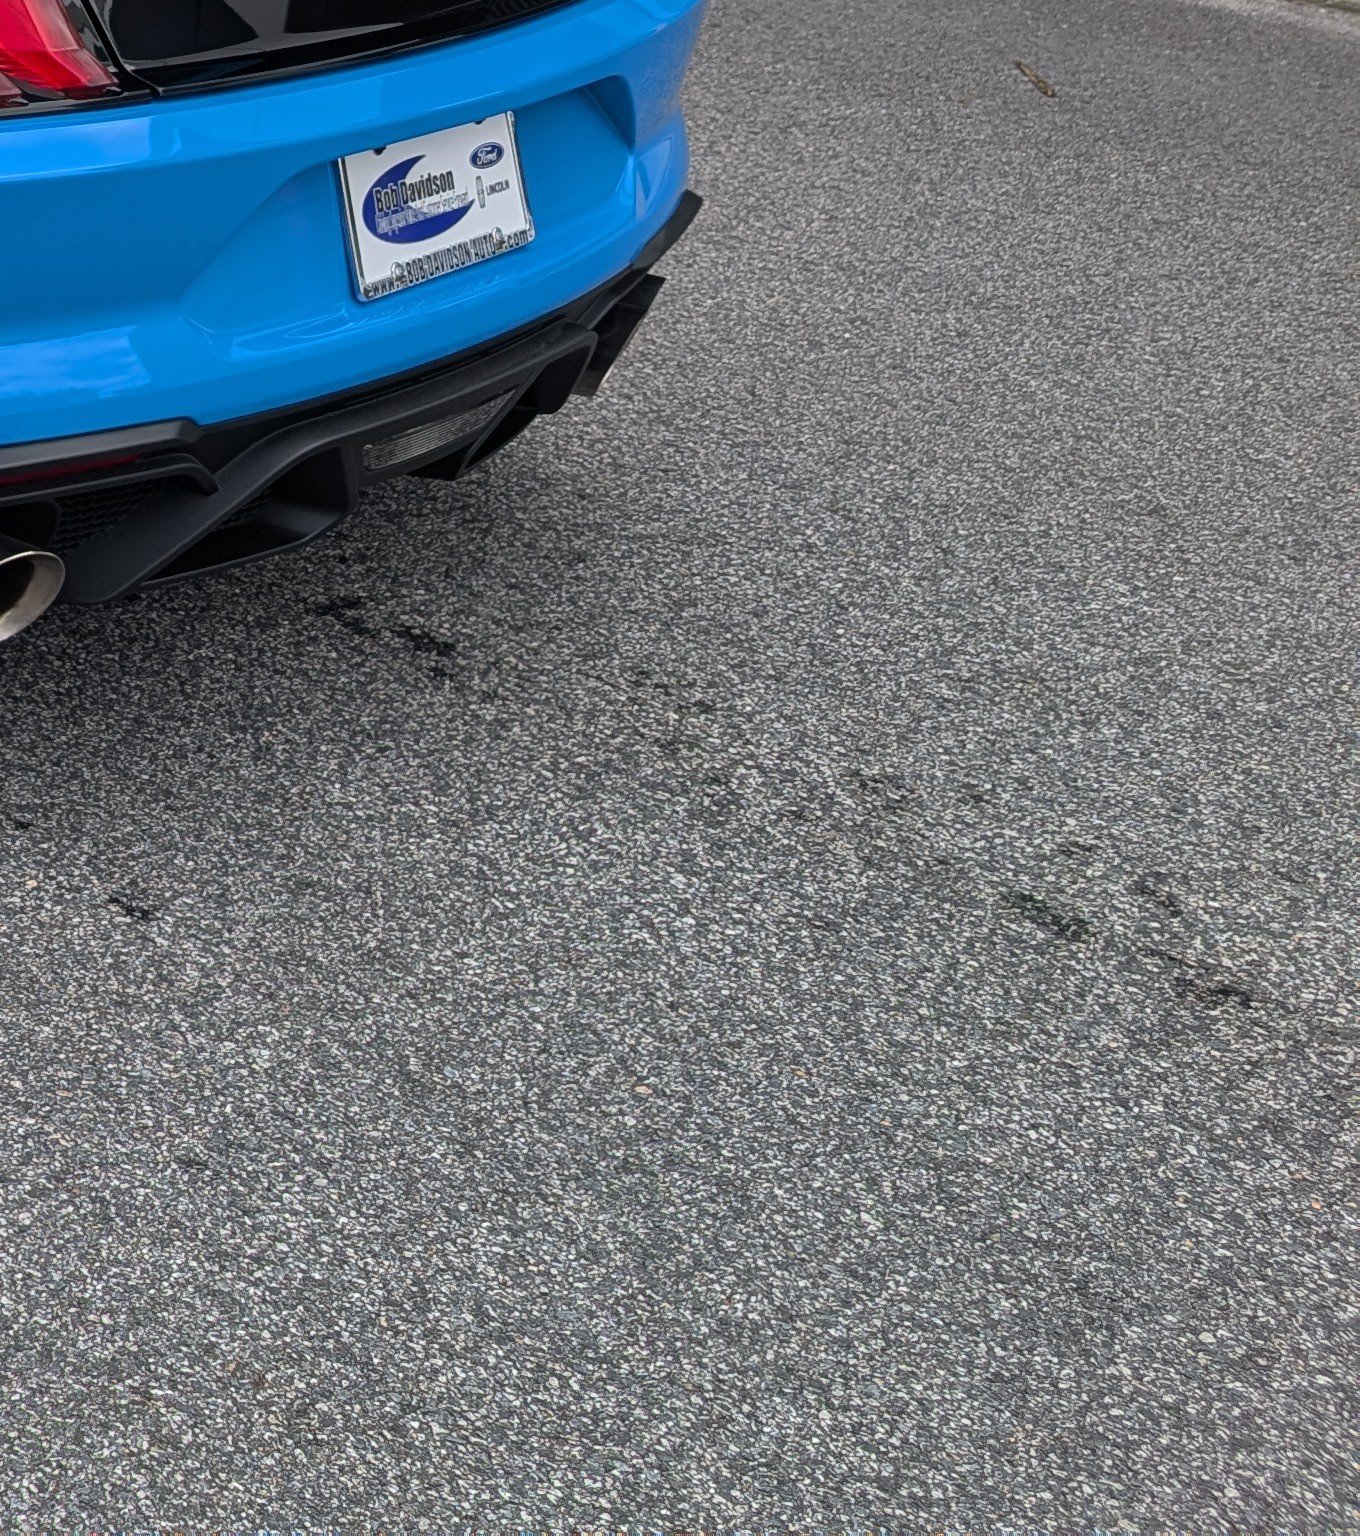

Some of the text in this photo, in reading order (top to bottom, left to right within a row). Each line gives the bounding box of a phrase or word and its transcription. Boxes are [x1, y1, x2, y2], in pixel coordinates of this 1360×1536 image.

[476, 146, 498, 166] Ford
[373, 183, 399, 214] Bob
[399, 169, 456, 206] Davidson
[485, 178, 510, 196] LINCOLN
